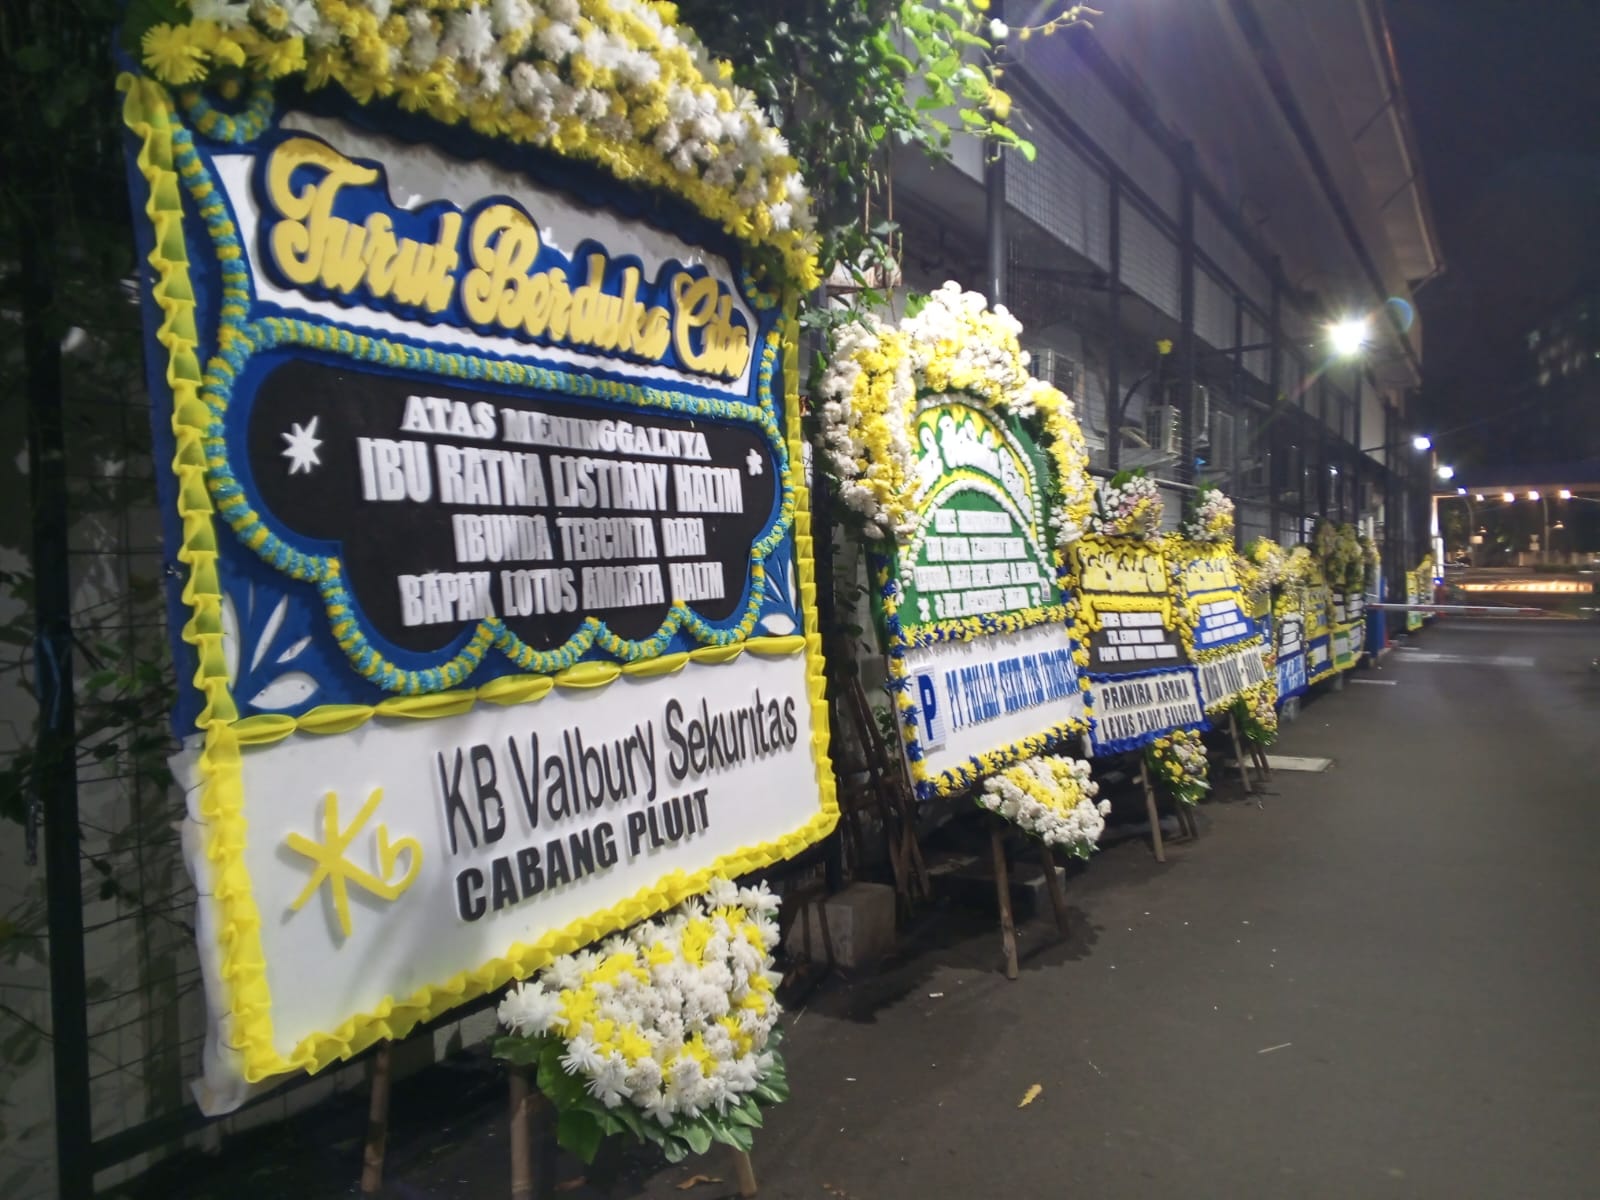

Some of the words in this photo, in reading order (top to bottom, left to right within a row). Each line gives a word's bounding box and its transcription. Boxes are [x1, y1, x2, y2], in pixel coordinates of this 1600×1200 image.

[266, 136, 462, 313] Turut
[462, 203, 672, 361] Berduka
[671, 271, 752, 379] Cita
[400, 395, 497, 440] ATAS
[500, 407, 713, 462] MENINGGALNYA
[357, 436, 432, 502] IBU
[434, 444, 549, 508] RATNA
[550, 454, 669, 512] LISTIANY
[673, 463, 745, 514] HALIM
[452, 513, 554, 563] IBUNDA
[555, 517, 659, 561] TERCINTA
[661, 518, 707, 557] DARI
[398, 571, 497, 627] BAPAK
[500, 567, 578, 617] LOTUS
[581, 563, 666, 611] AMARTA
[668, 561, 726, 602] HALIM
[1100, 713, 1136, 741] LEXUS
[1137, 708, 1164, 732] PLUIT
[1102, 683, 1153, 710] PRAWIRA
[437, 742, 507, 856] KB
[509, 718, 658, 830] Valbury
[664, 687, 798, 782] Sekuritas
[455, 820, 619, 923] CABANG
[627, 787, 712, 857] PLUIT
